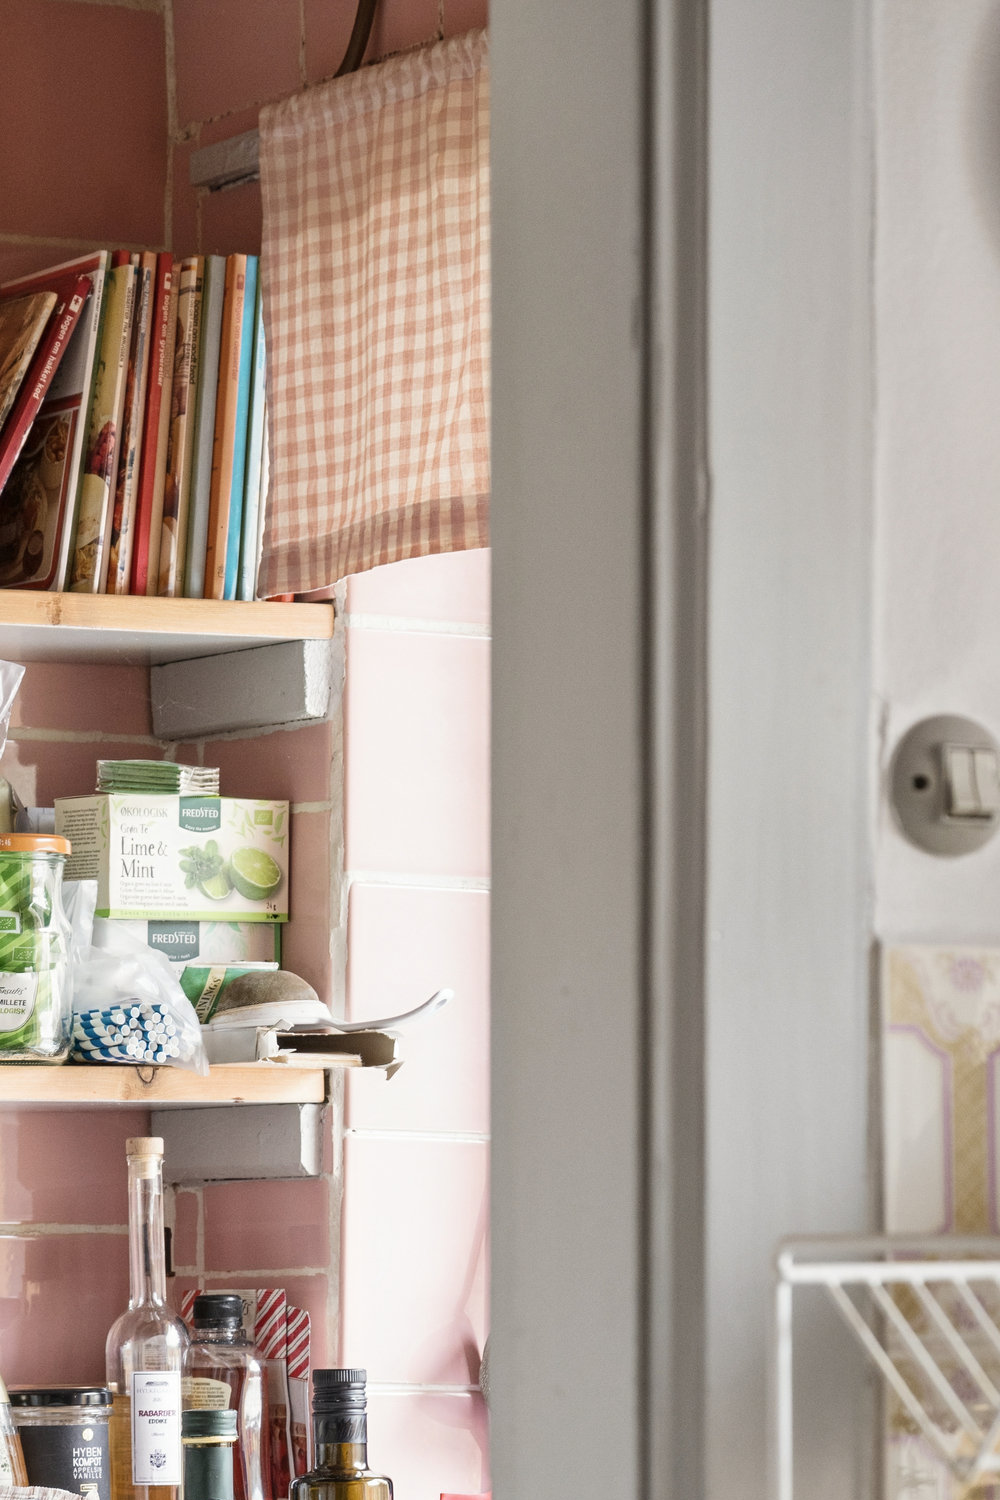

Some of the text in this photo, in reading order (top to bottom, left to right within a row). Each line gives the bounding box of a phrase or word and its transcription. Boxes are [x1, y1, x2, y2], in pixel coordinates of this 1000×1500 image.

[59, 315, 73, 340] bogen
[52, 341, 61, 354] om
[120, 806, 219, 819] ØKOLOGISK FREDSTED
[120, 824, 148, 834] Grøn Te
[120, 836, 168, 856] Lime &
[120, 859, 155, 878] Mint
[152, 931, 196, 944] FREDSTED
[72, 1447, 102, 1457] HYBEN
[72, 1457, 102, 1466] KOMPOT
[73, 1472, 102, 1480] VANILLE
